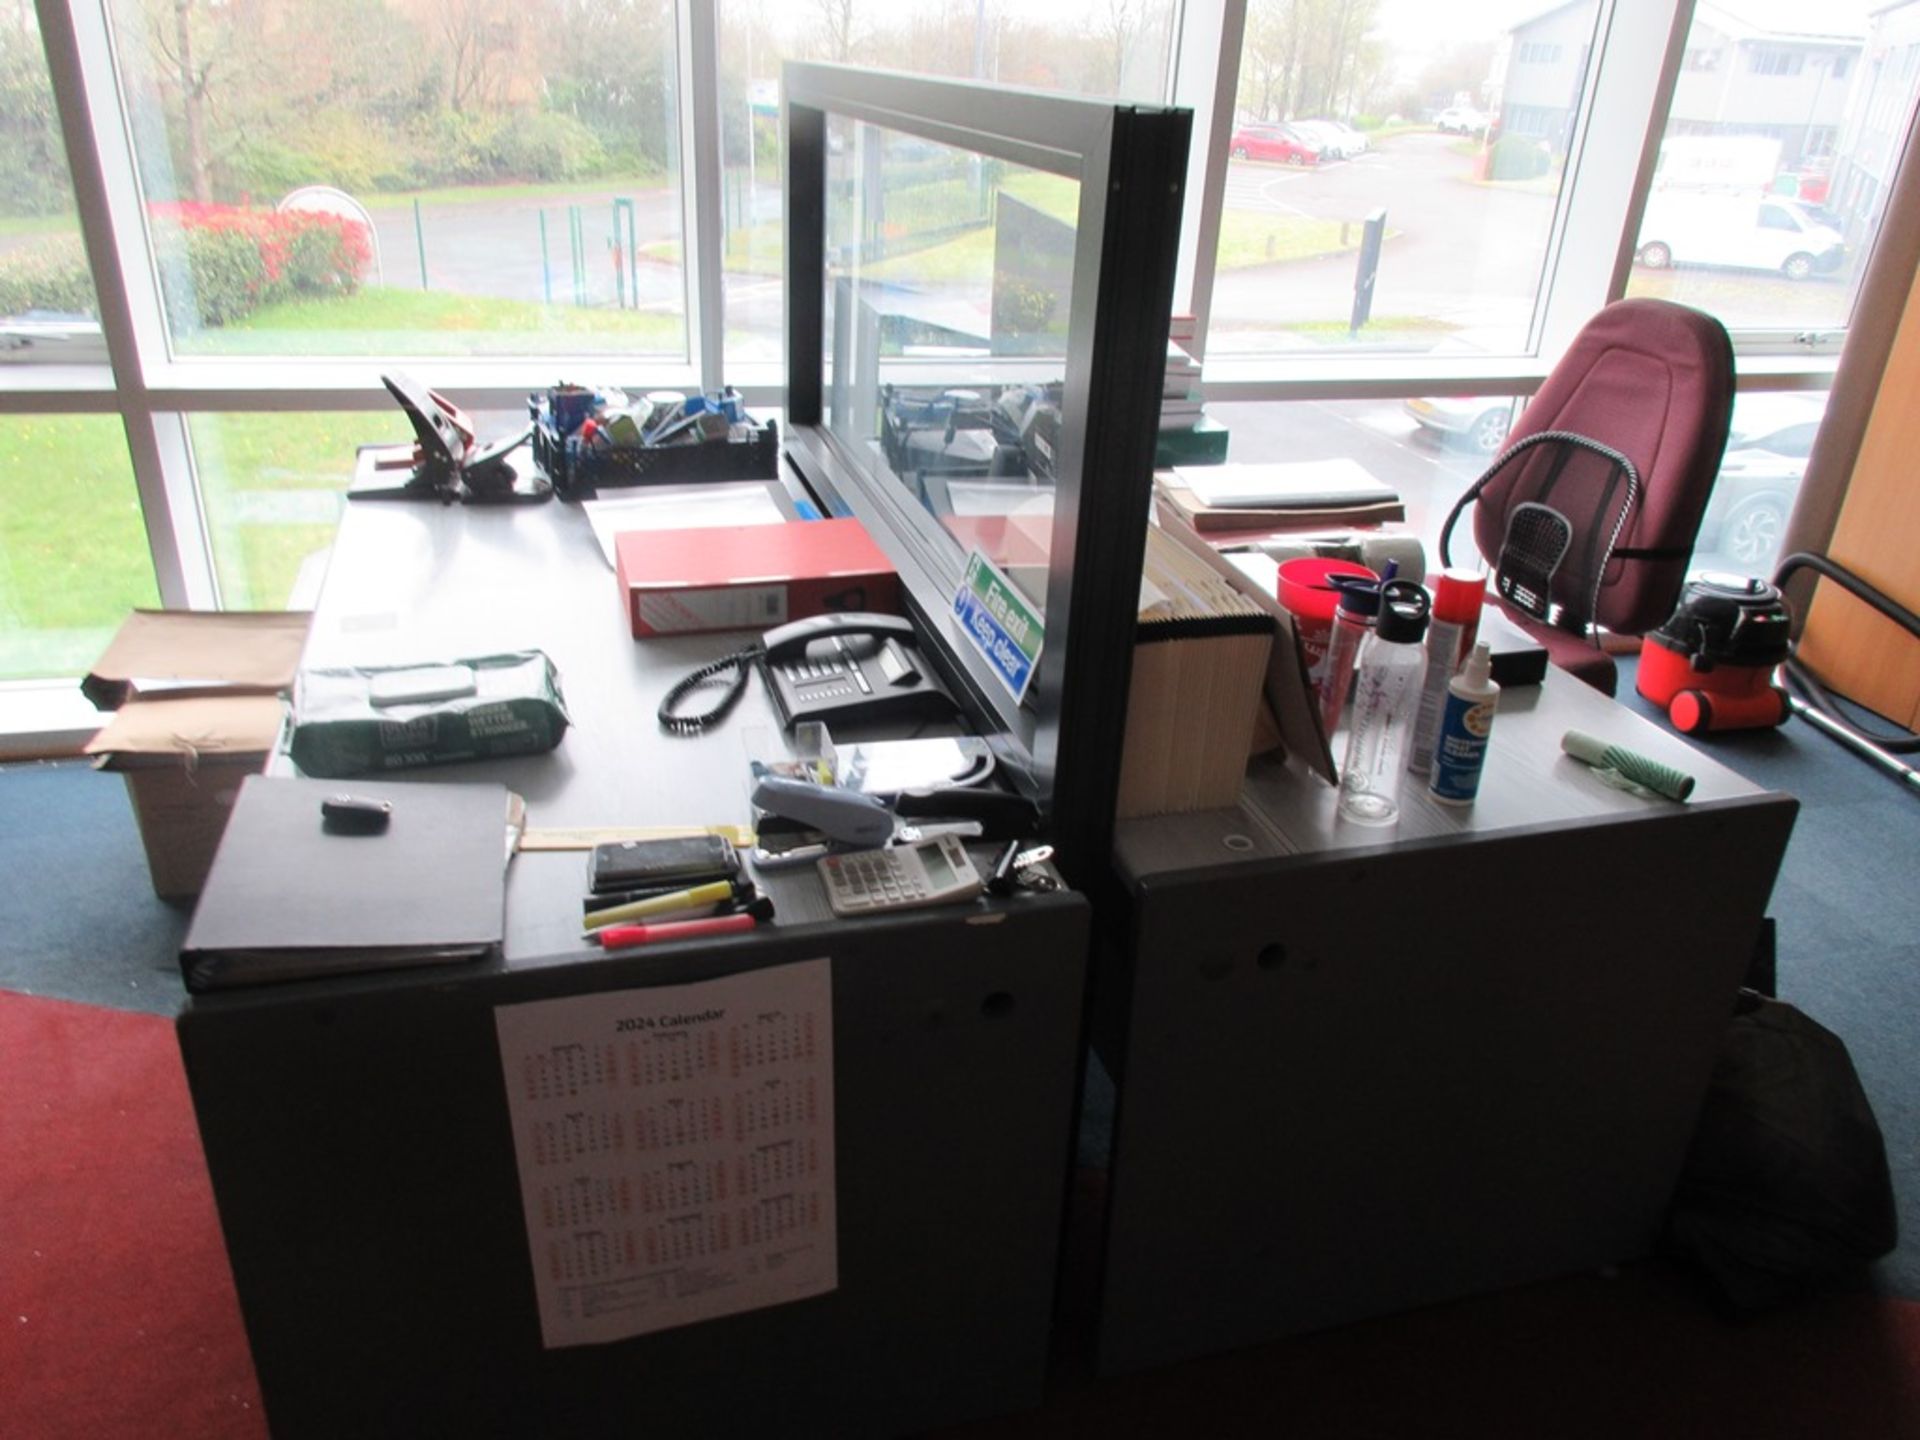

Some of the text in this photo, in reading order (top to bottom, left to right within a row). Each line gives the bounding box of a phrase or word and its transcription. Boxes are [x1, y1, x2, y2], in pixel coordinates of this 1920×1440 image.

[969, 603, 1023, 679] Keep clear
[985, 580, 1029, 645] Fire exit
[615, 1009, 726, 1032] 2024 Calendar
